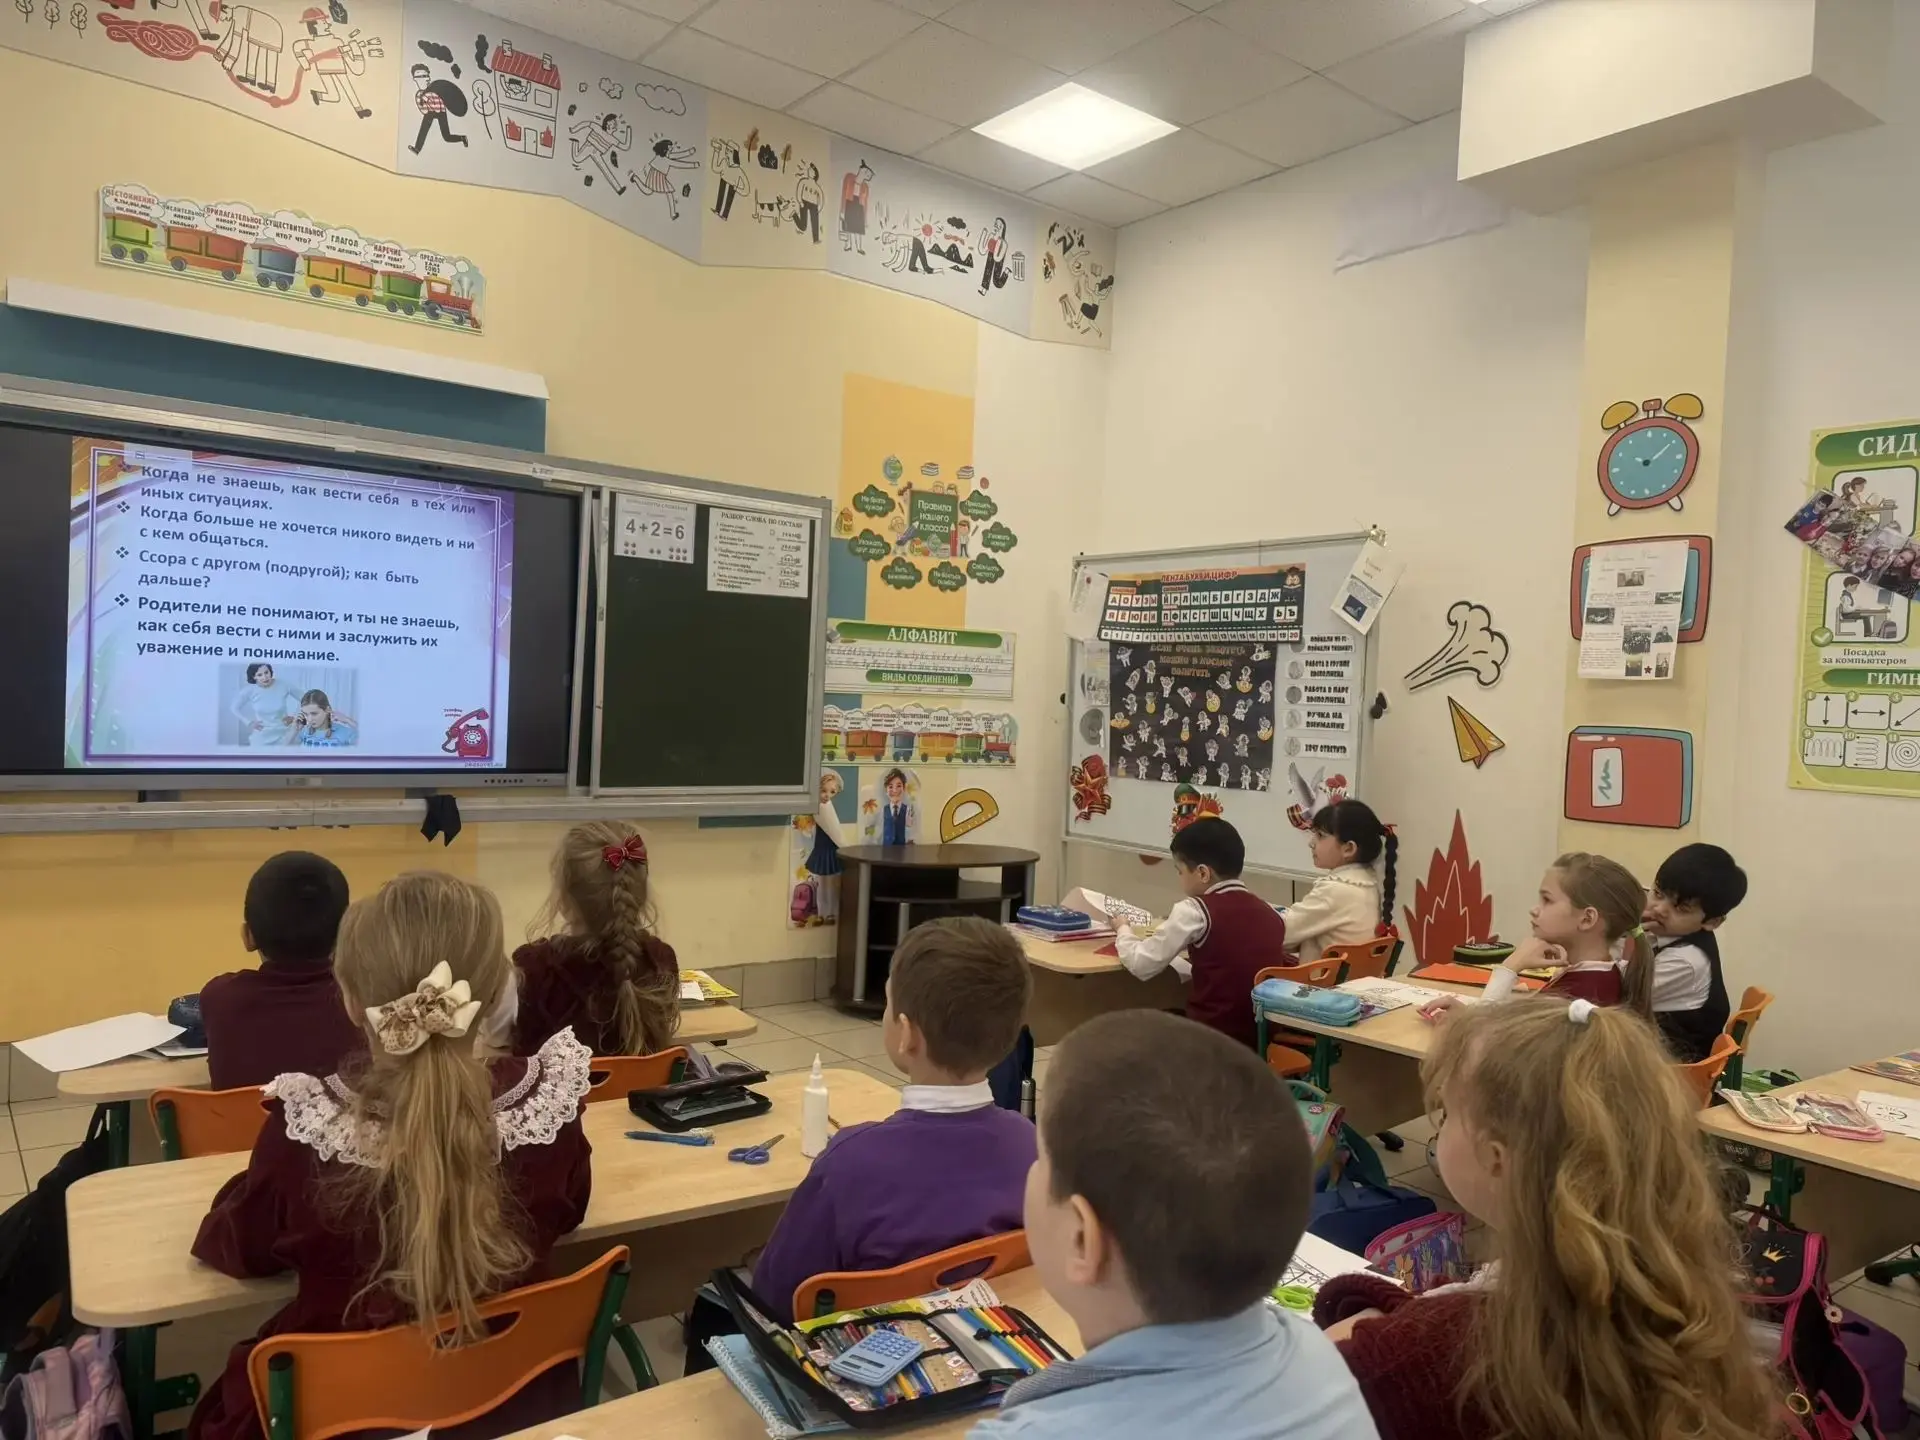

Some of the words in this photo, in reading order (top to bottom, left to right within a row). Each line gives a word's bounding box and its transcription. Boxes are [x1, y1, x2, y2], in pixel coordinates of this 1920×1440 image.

[206, 207, 262, 225] ПРИЛАГАТЕЛЬНОЕ
[265, 219, 324, 238] СУЩЕСТВИТЕЛЬНОЕ
[331, 235, 359, 248] ГЛАГОЛ
[373, 244, 401, 256] НАРЕЧИЕ
[1858, 432, 1919, 460] СИД
[142, 465, 189, 483] Когда
[196, 474, 216, 485] не
[223, 476, 285, 494] знаешь,
[292, 484, 317, 496] как
[323, 487, 362, 501] вести
[368, 493, 400, 506] себя
[411, 498, 419, 508] в
[424, 499, 446, 511] тех
[451, 503, 476, 514] или
[141, 487, 184, 501] иных
[189, 492, 273, 510] ситуациях.
[918, 500, 952, 512] Правила
[721, 511, 745, 521] РАЗБОР
[745, 515, 767, 525] СЛОВА
[920, 512, 950, 523] нашего
[141, 505, 188, 522] Когда
[194, 510, 254, 528] больше
[259, 519, 277, 530] не
[282, 521, 337, 536] хочется
[342, 527, 391, 542] никого
[395, 533, 442, 547] видеть
[446, 538, 454, 548] и
[458, 540, 475, 550] ни
[920, 523, 949, 533] класса
[140, 527, 148, 537] с
[152, 529, 184, 540] кем
[189, 531, 269, 549] общаться.
[139, 549, 187, 567] Ссора
[191, 556, 199, 566] с
[203, 558, 261, 571] другом
[265, 560, 350, 581] (подругой);
[354, 570, 378, 581] как
[385, 570, 419, 585] быть
[138, 573, 211, 588] дальше?
[1211, 570, 1238, 581] ЦИФР
[138, 596, 222, 614] Родители
[227, 605, 247, 616] не
[252, 606, 339, 624] понимают,
[343, 612, 353, 622] и
[357, 613, 376, 624] ты
[380, 615, 398, 625] не
[402, 616, 459, 631] знаешь,
[138, 620, 167, 632] как
[172, 621, 211, 635] себя
[216, 625, 261, 637] вести
[265, 628, 274, 638] с
[278, 628, 321, 641] ними
[326, 631, 335, 641] и
[339, 632, 417, 646] заслужить
[421, 637, 438, 647] их
[887, 627, 958, 645] АЛФАВИТ
[137, 641, 223, 657] уважение
[228, 647, 238, 657] и
[243, 647, 339, 661] понимание.
[1843, 648, 1886, 657] Посадка
[1835, 657, 1907, 666] компьютером
[882, 672, 907, 682] ВИДЫ
[907, 673, 959, 685] СОЕДИНЕНИЙ
[1867, 671, 1920, 685] ГИМН
[1307, 711, 1330, 719] РУЧКА
